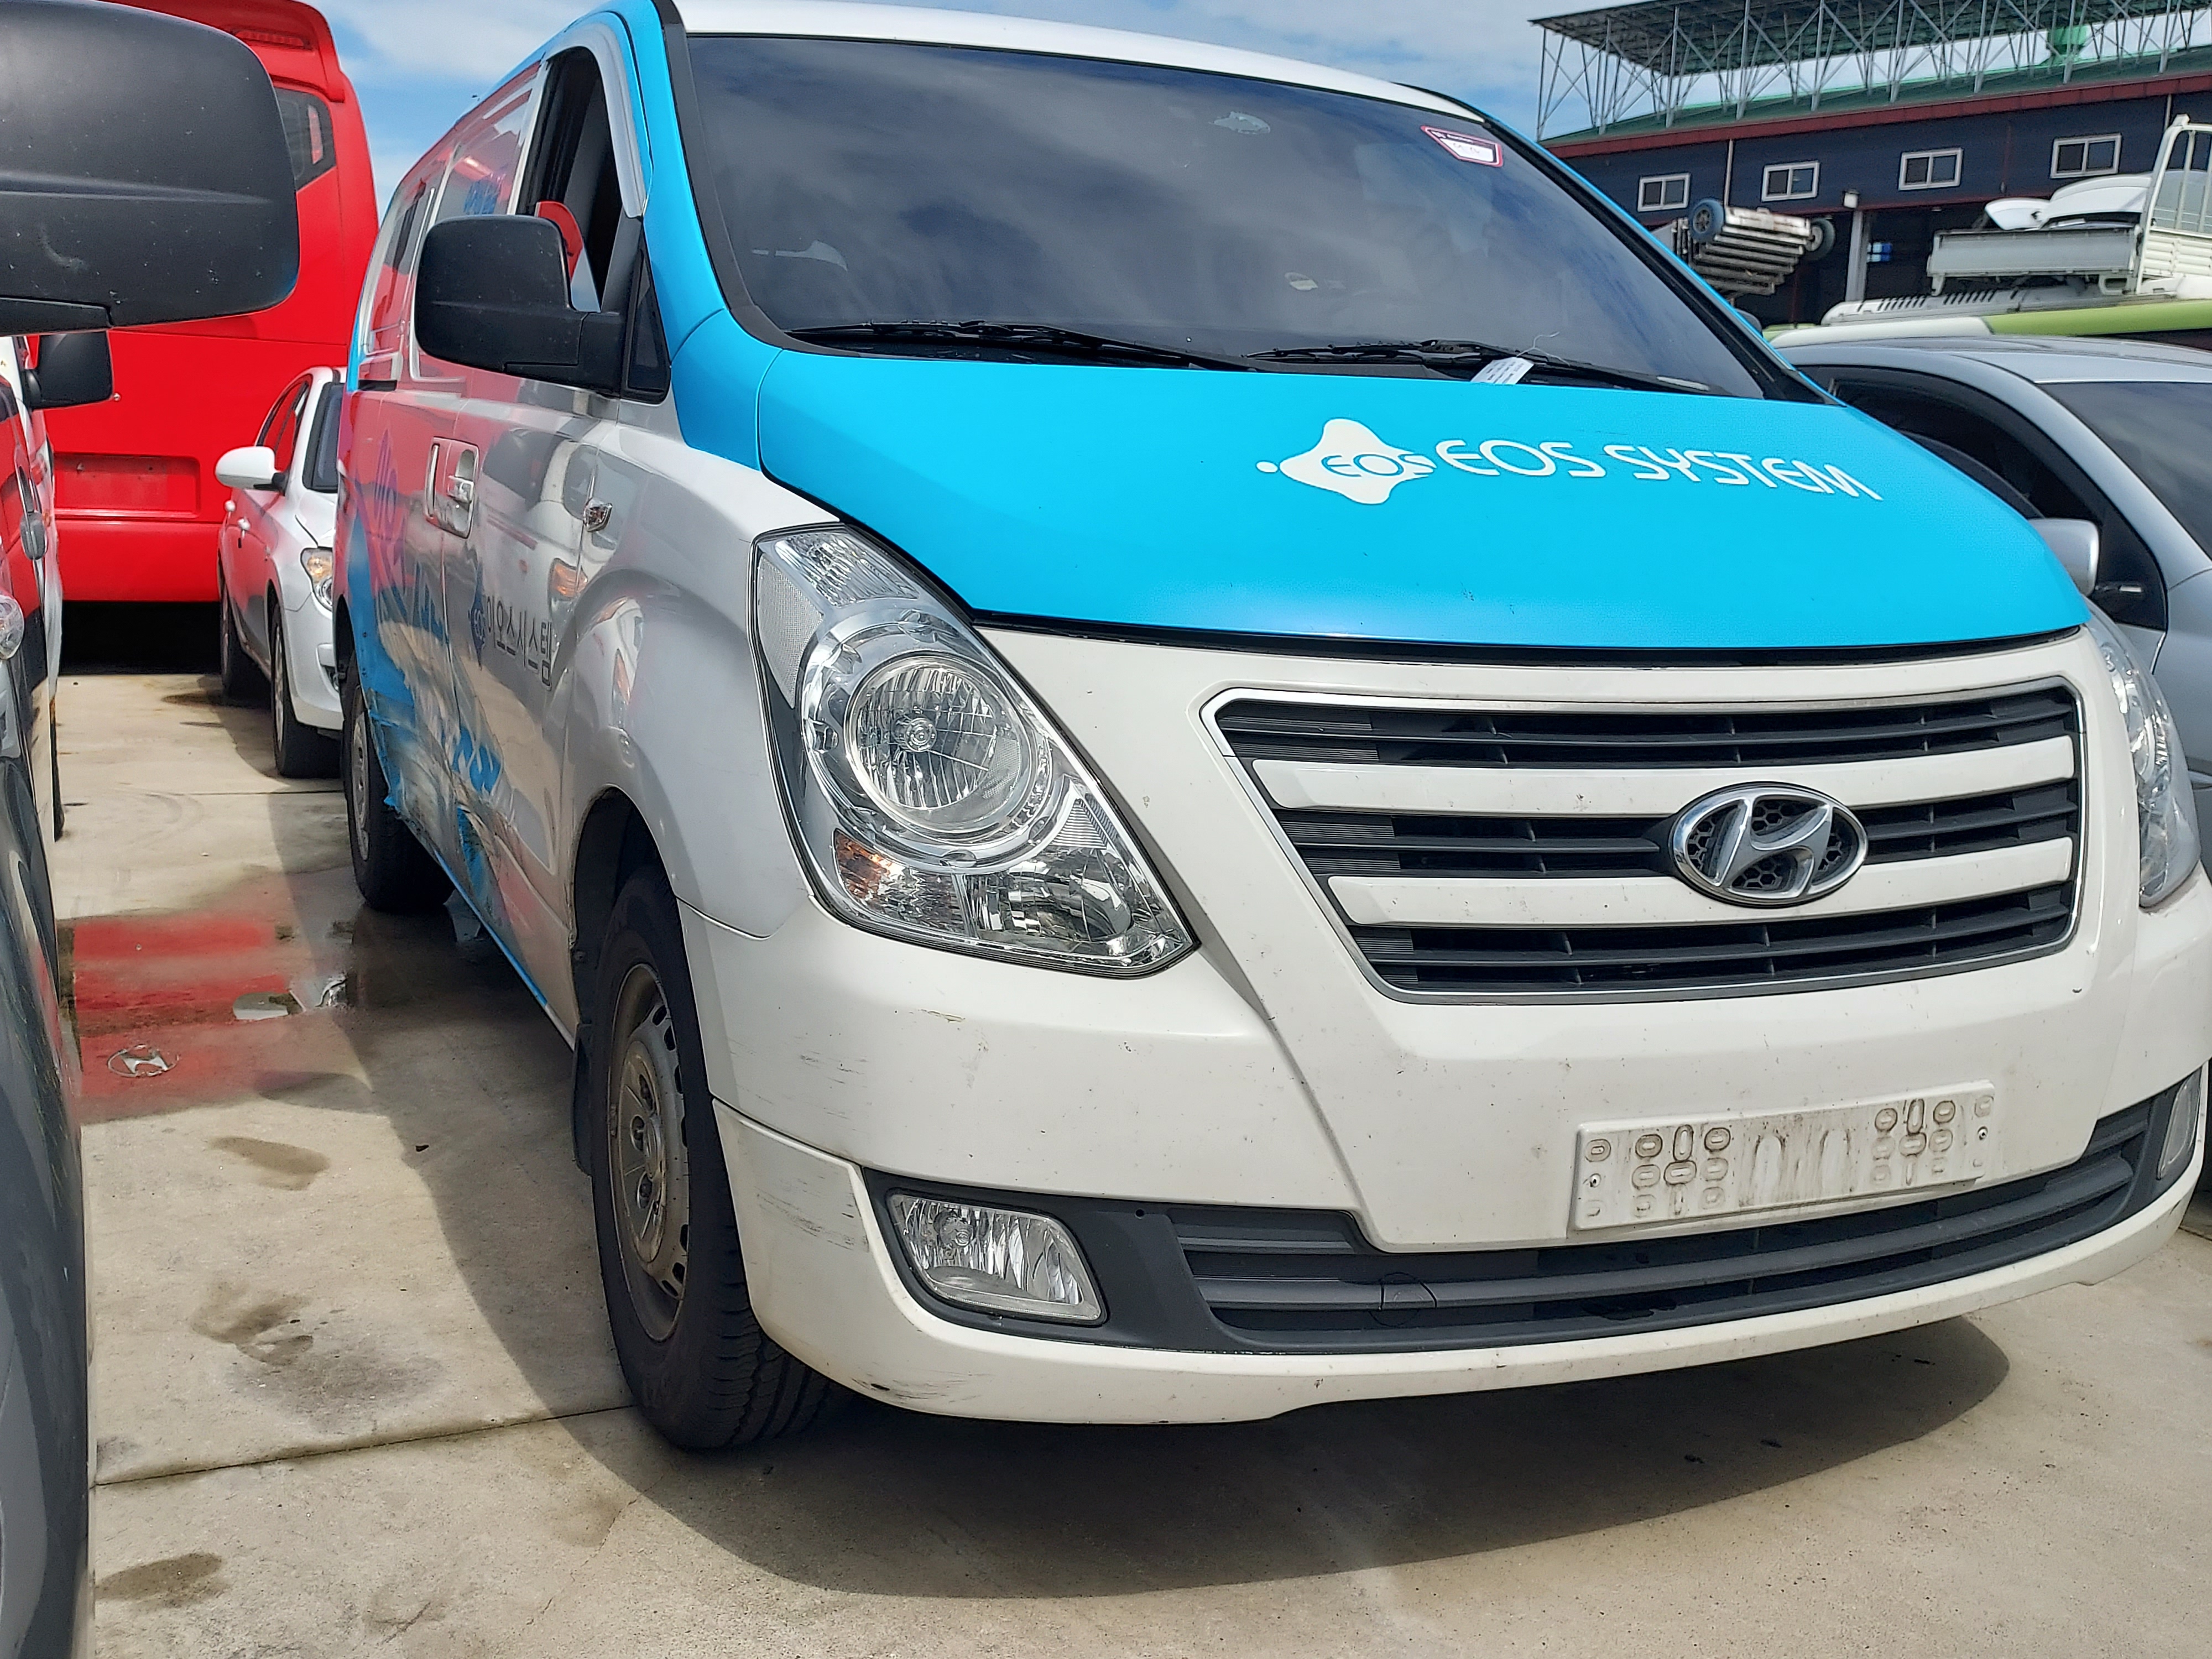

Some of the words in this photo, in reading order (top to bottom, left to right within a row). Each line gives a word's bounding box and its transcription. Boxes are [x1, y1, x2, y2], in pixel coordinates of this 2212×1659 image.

[1321, 453, 1438, 477] EOS
[1436, 440, 1606, 477] EOS
[1603, 445, 1882, 500] SYSTEM
[487, 596, 552, 687] 이오스시스템
